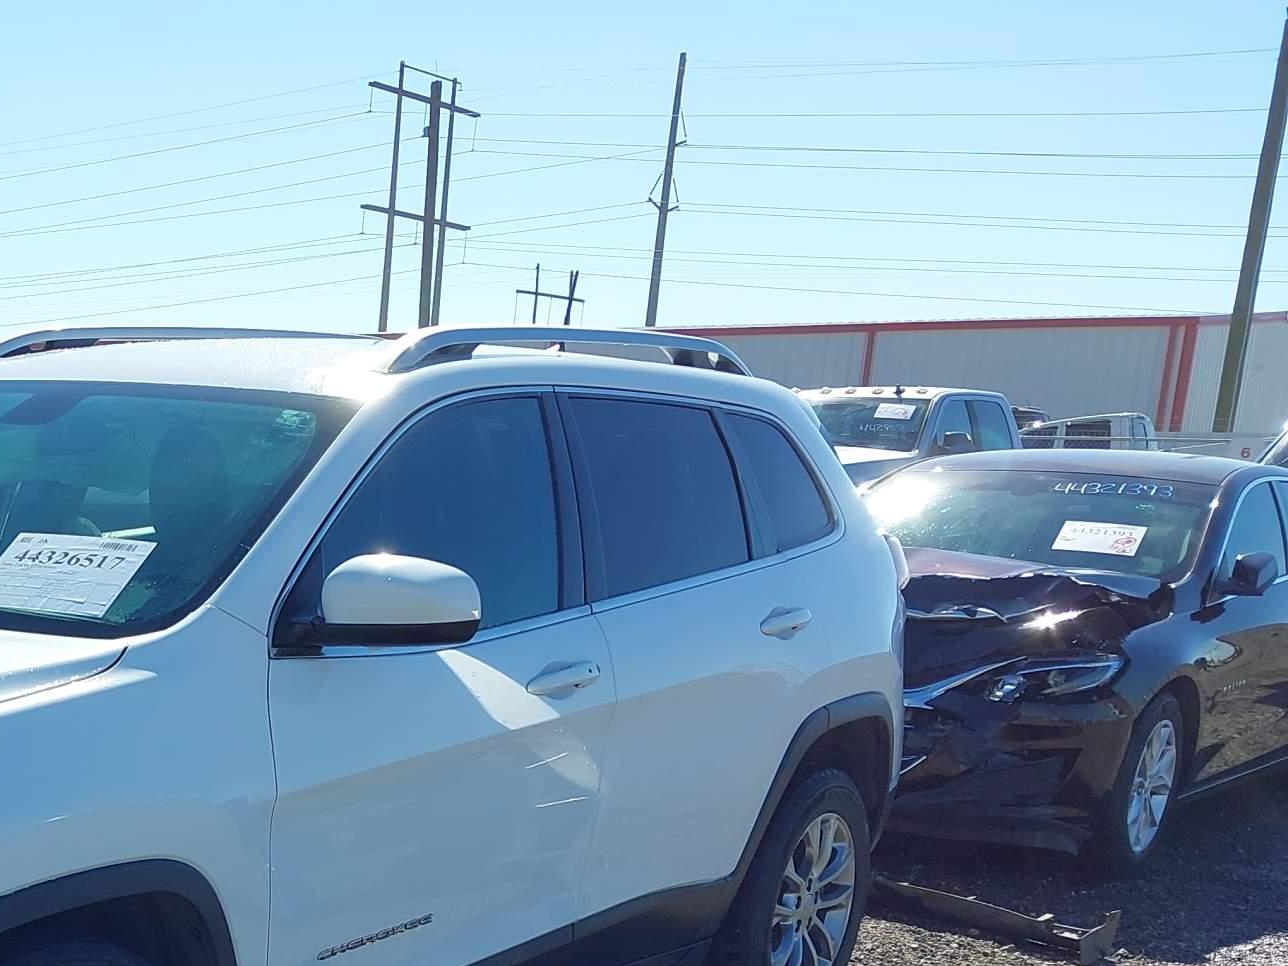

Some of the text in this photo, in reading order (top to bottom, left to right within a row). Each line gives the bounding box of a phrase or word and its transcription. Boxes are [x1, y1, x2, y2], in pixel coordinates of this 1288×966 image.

[1054, 482, 1174, 497] 44321393
[14, 549, 127, 570] 44326517
[316, 913, 434, 960] CHEROKEE
